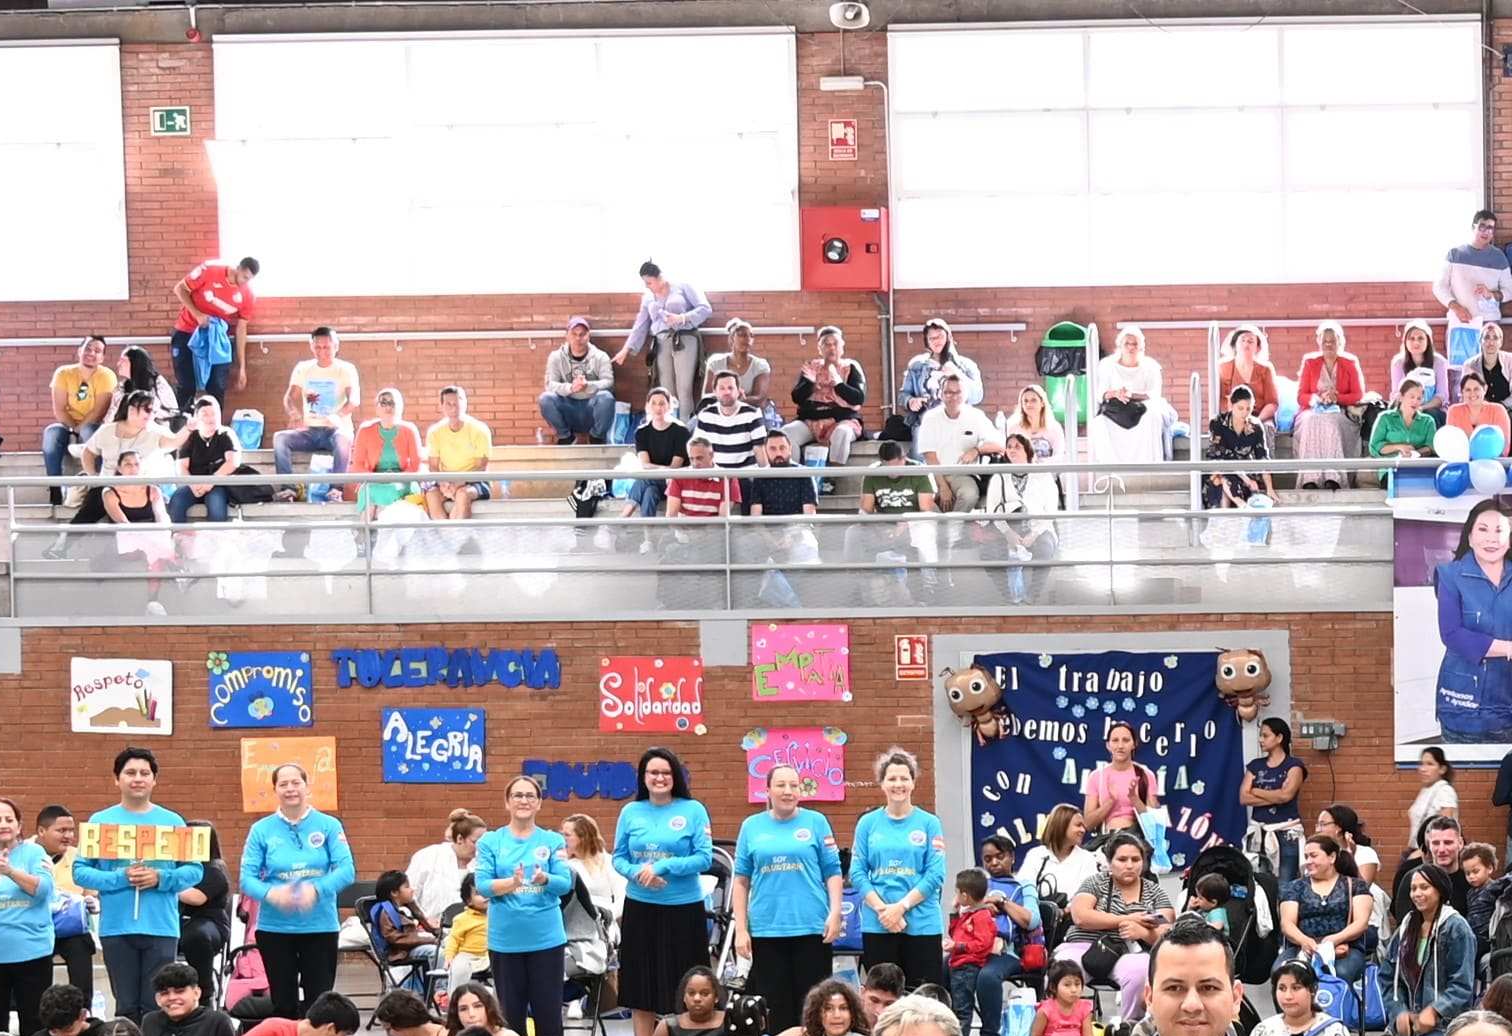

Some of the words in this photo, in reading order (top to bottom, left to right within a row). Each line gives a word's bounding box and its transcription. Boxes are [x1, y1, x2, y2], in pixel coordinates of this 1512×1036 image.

[599, 664, 703, 724] Solidaridad
[1058, 667, 1164, 697] trabajo
[998, 714, 1088, 744] ebemos
[1104, 716, 1216, 758] hcerlo
[982, 770, 1032, 801] con
[80, 823, 211, 860] RESPETO
